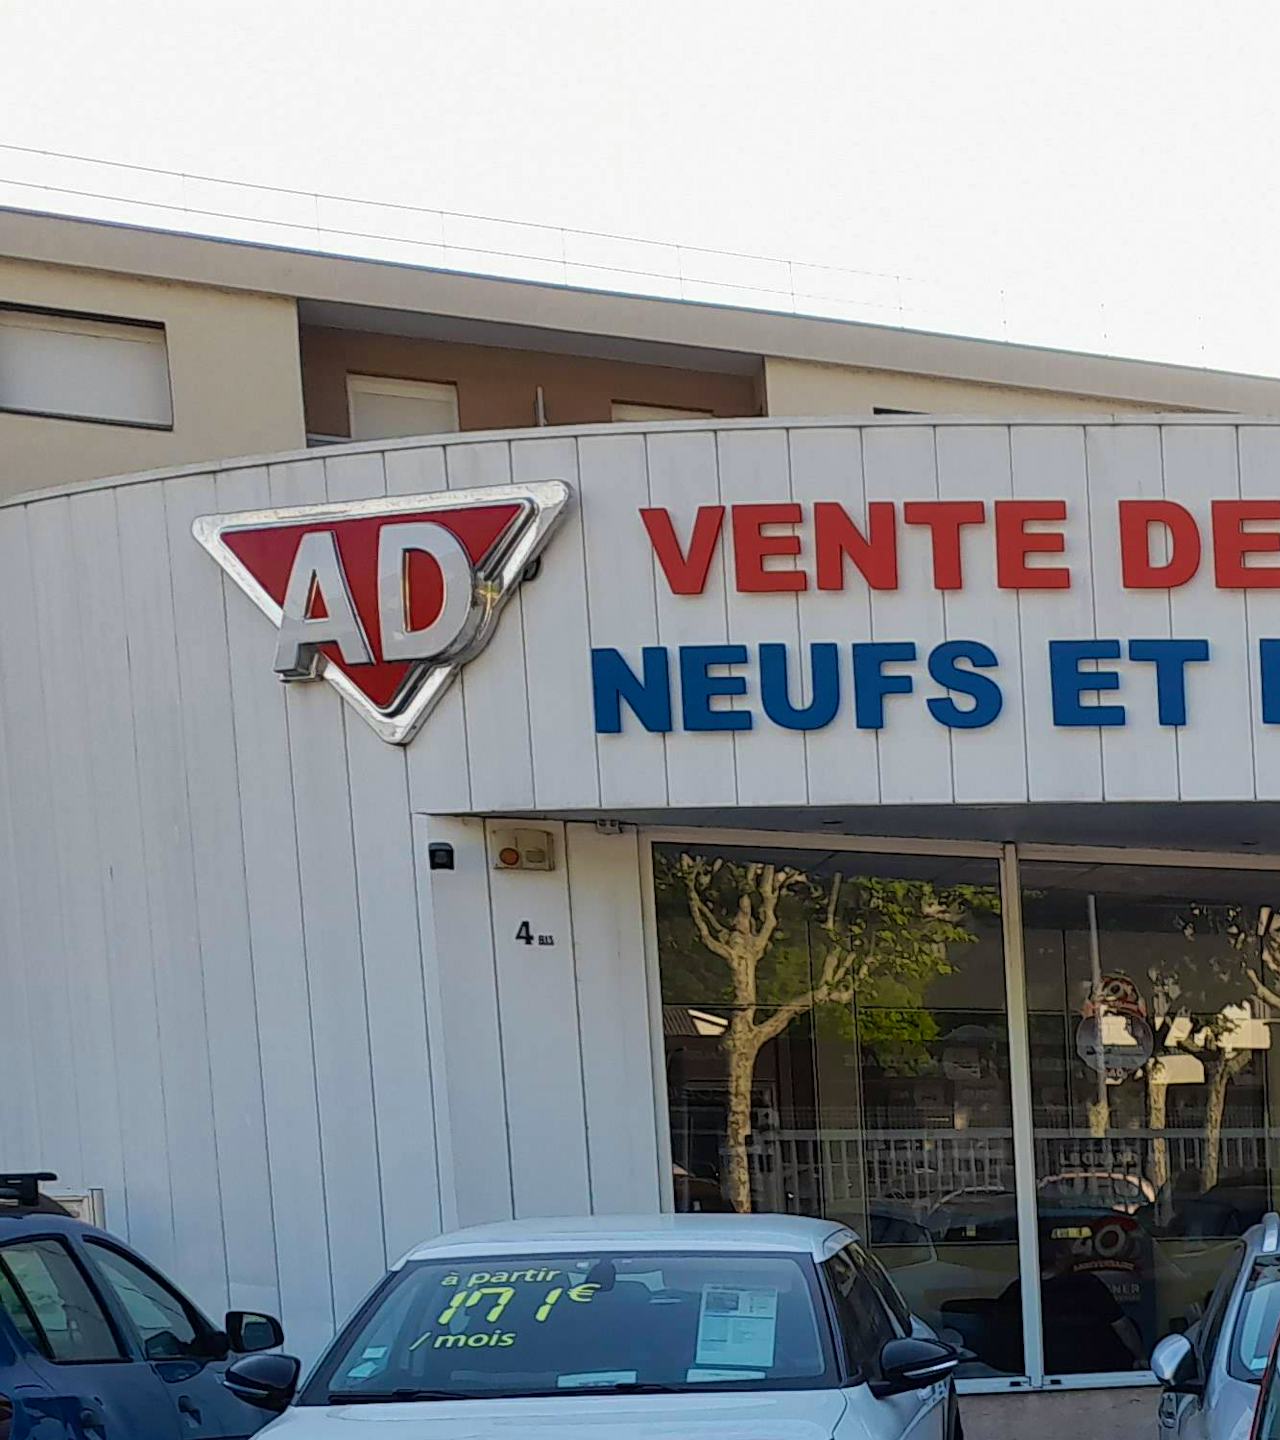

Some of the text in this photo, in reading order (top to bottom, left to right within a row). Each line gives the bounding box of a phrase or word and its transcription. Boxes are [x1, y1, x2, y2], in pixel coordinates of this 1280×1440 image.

[641, 501, 1070, 596] VENTE
[273, 521, 473, 674] AD
[592, 641, 1003, 734] NEUFS
[1050, 640, 1210, 728] ET
[515, 920, 534, 946] 4
[441, 1267, 562, 1288] à partir
